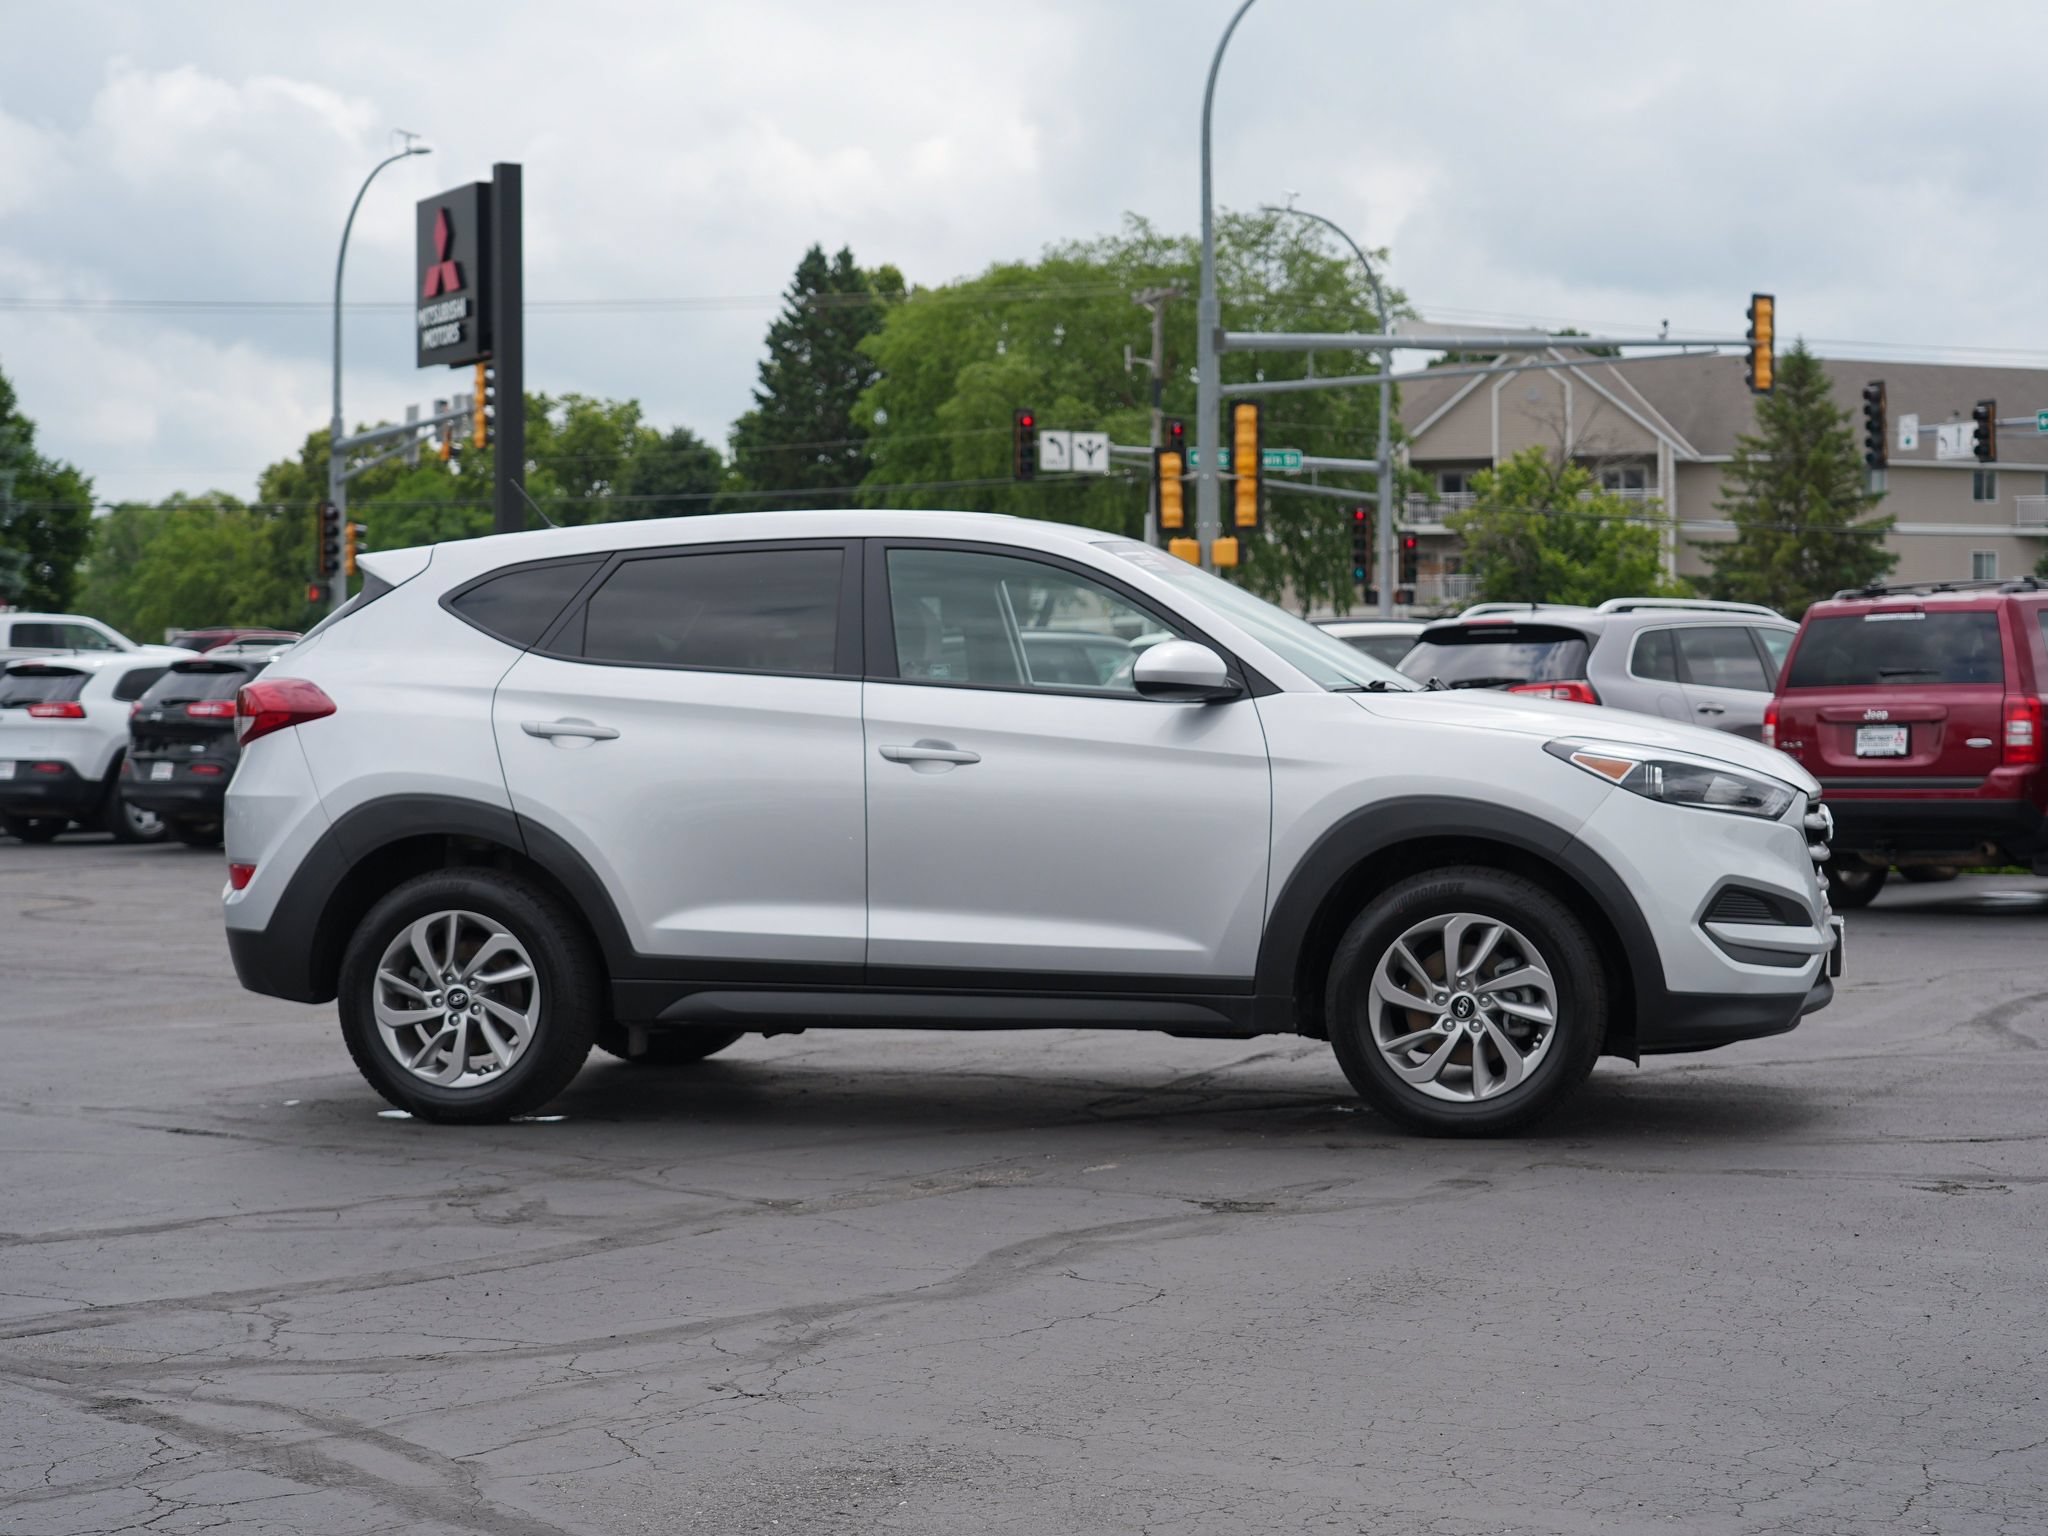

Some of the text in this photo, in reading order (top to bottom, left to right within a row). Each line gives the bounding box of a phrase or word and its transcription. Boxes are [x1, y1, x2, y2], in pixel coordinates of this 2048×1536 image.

[419, 297, 467, 327] MITSUBISHI
[422, 321, 460, 350] MOTORS
[1863, 708, 1888, 720] Jeep
